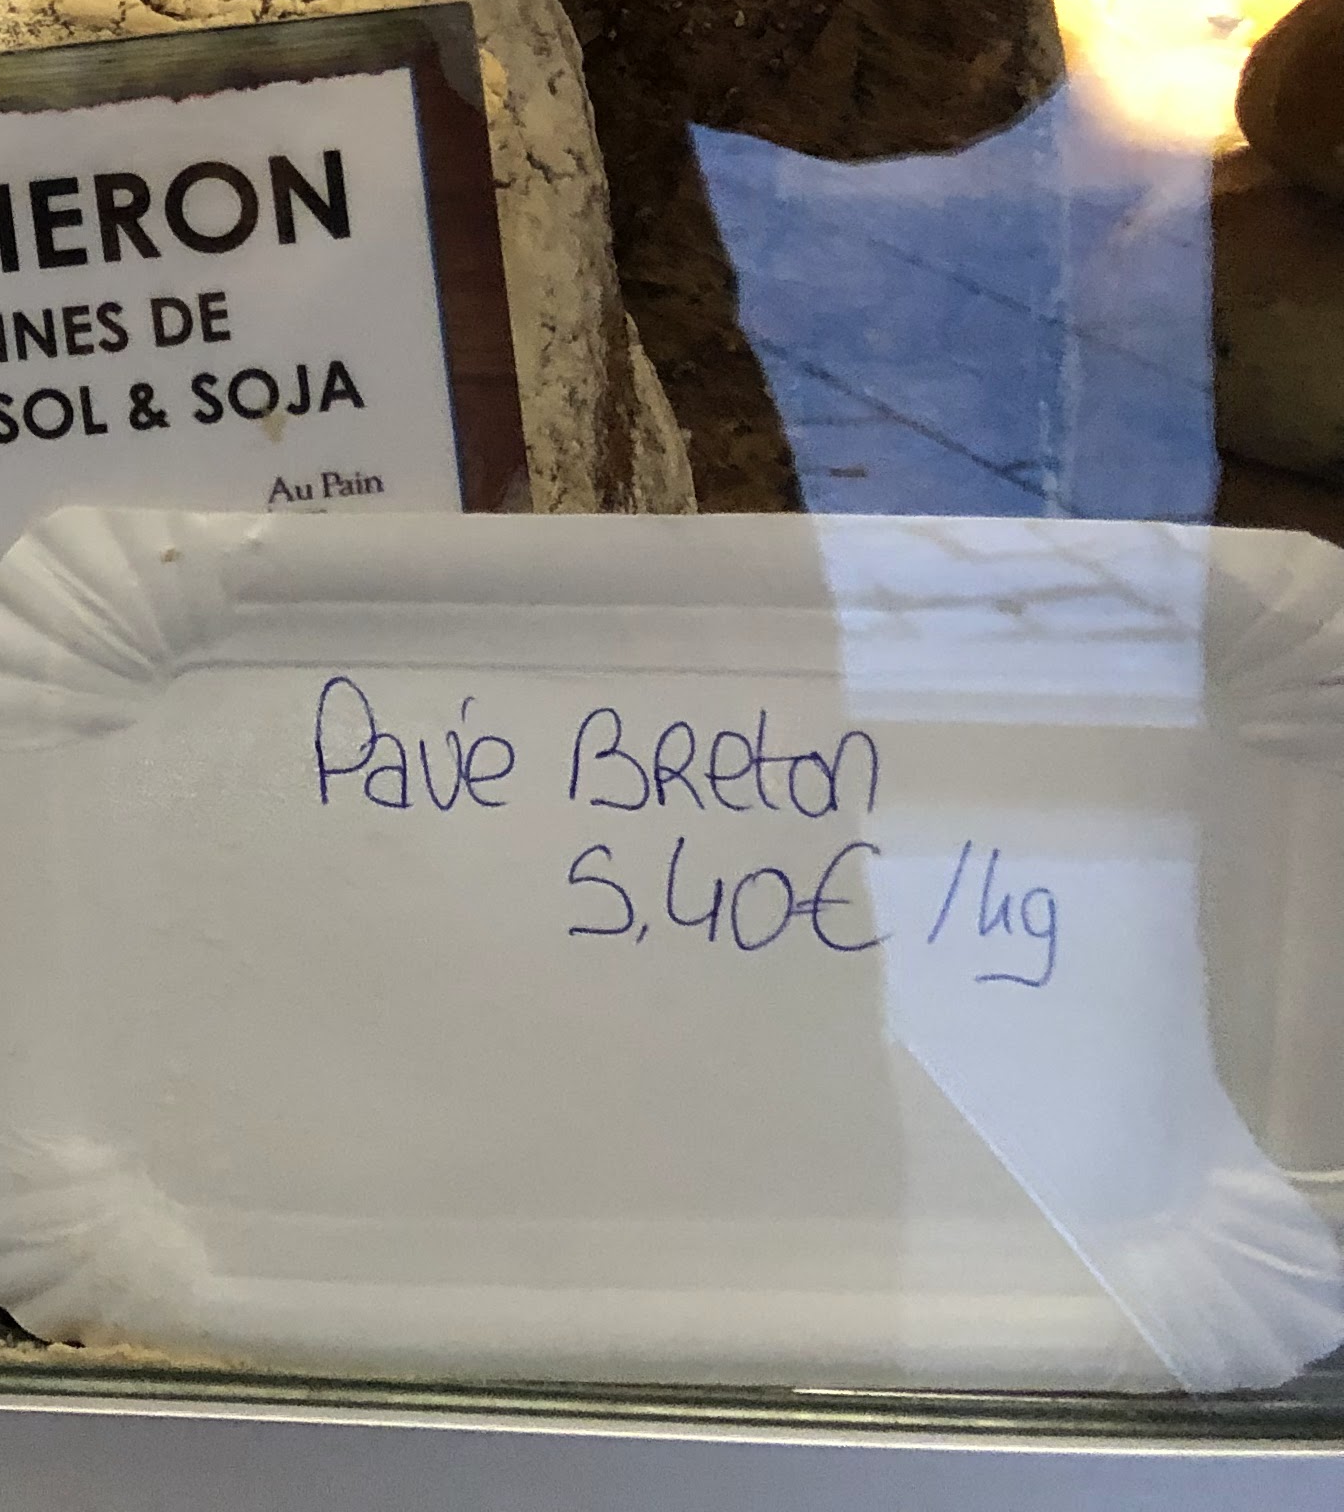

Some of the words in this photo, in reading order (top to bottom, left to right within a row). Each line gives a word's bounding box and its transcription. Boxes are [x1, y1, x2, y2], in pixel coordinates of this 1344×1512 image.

[150, 291, 230, 347] DE
[129, 382, 170, 430] &
[191, 360, 365, 424] SOJA
[269, 477, 313, 503] Au
[321, 472, 384, 498] Pain
[315, 676, 515, 810] Pavé
